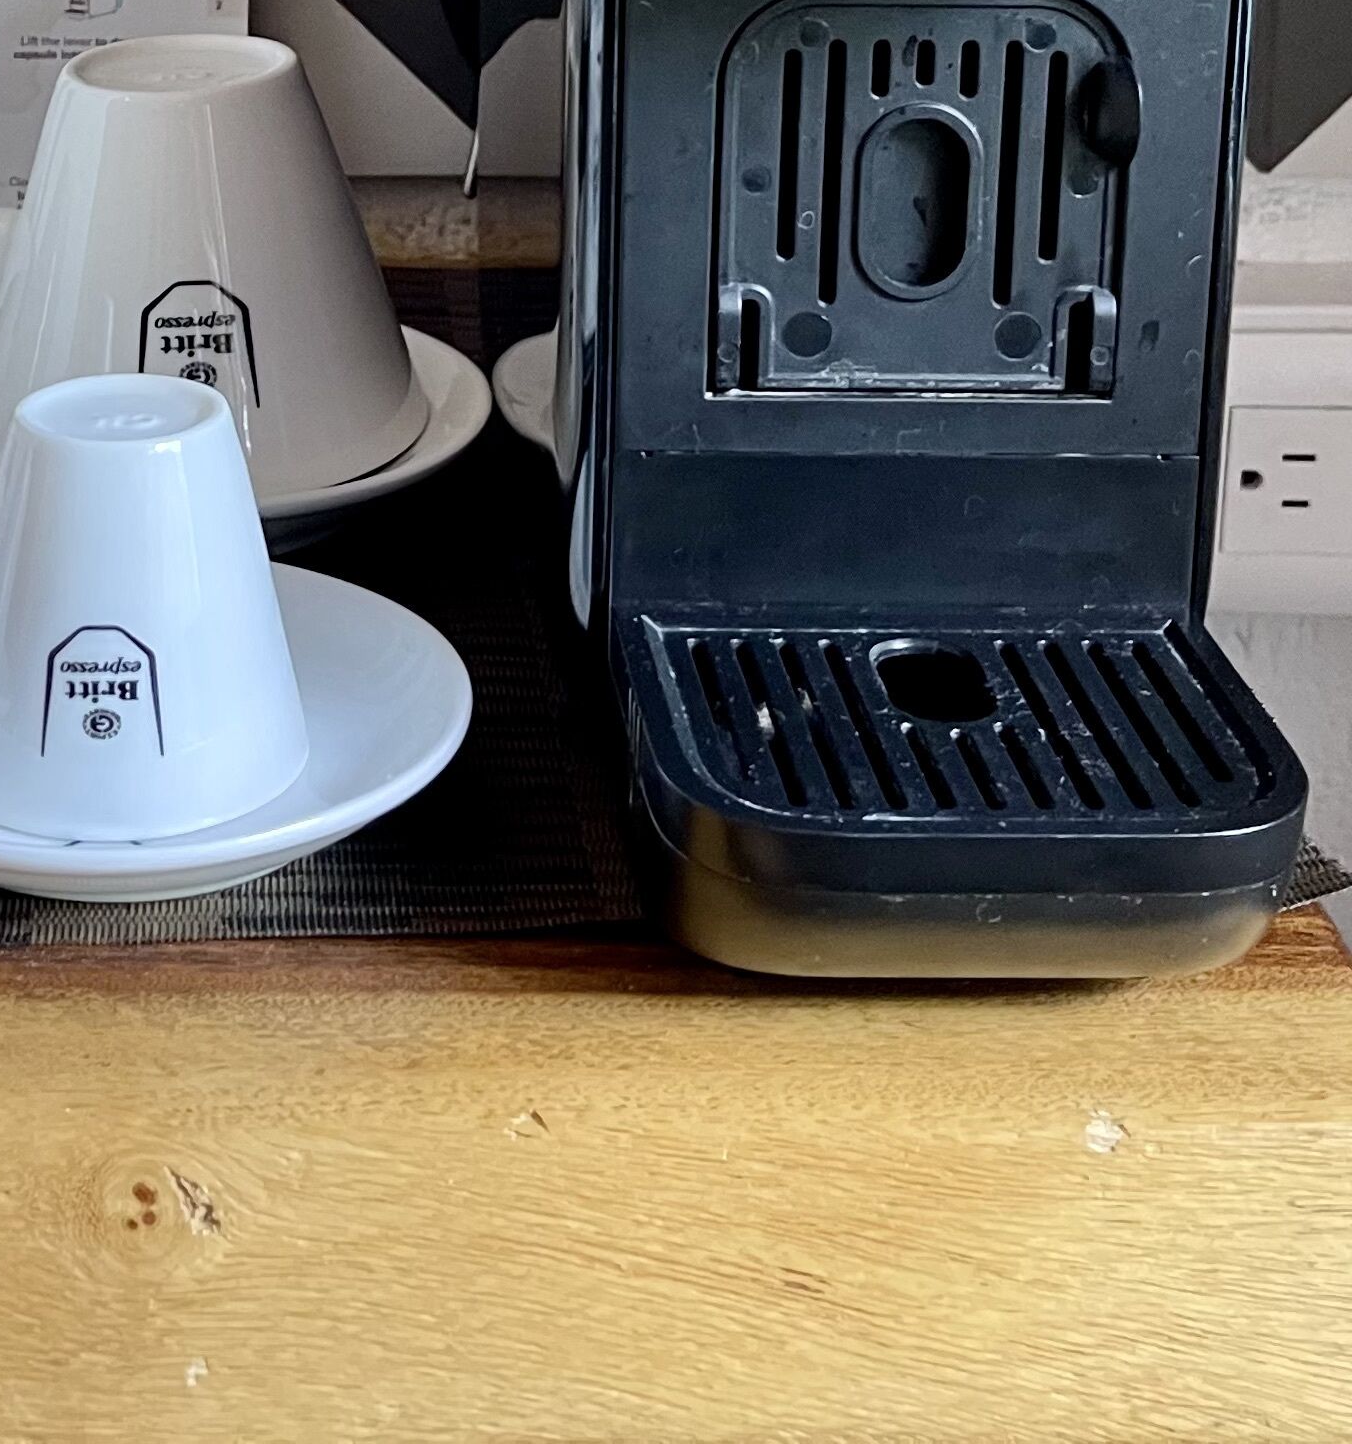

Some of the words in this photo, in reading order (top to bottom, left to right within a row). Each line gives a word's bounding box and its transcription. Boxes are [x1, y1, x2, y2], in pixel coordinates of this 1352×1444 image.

[154, 310, 237, 329] espresso
[159, 332, 234, 358] Britt
[59, 656, 142, 675] espresso
[64, 679, 140, 704] Britt
